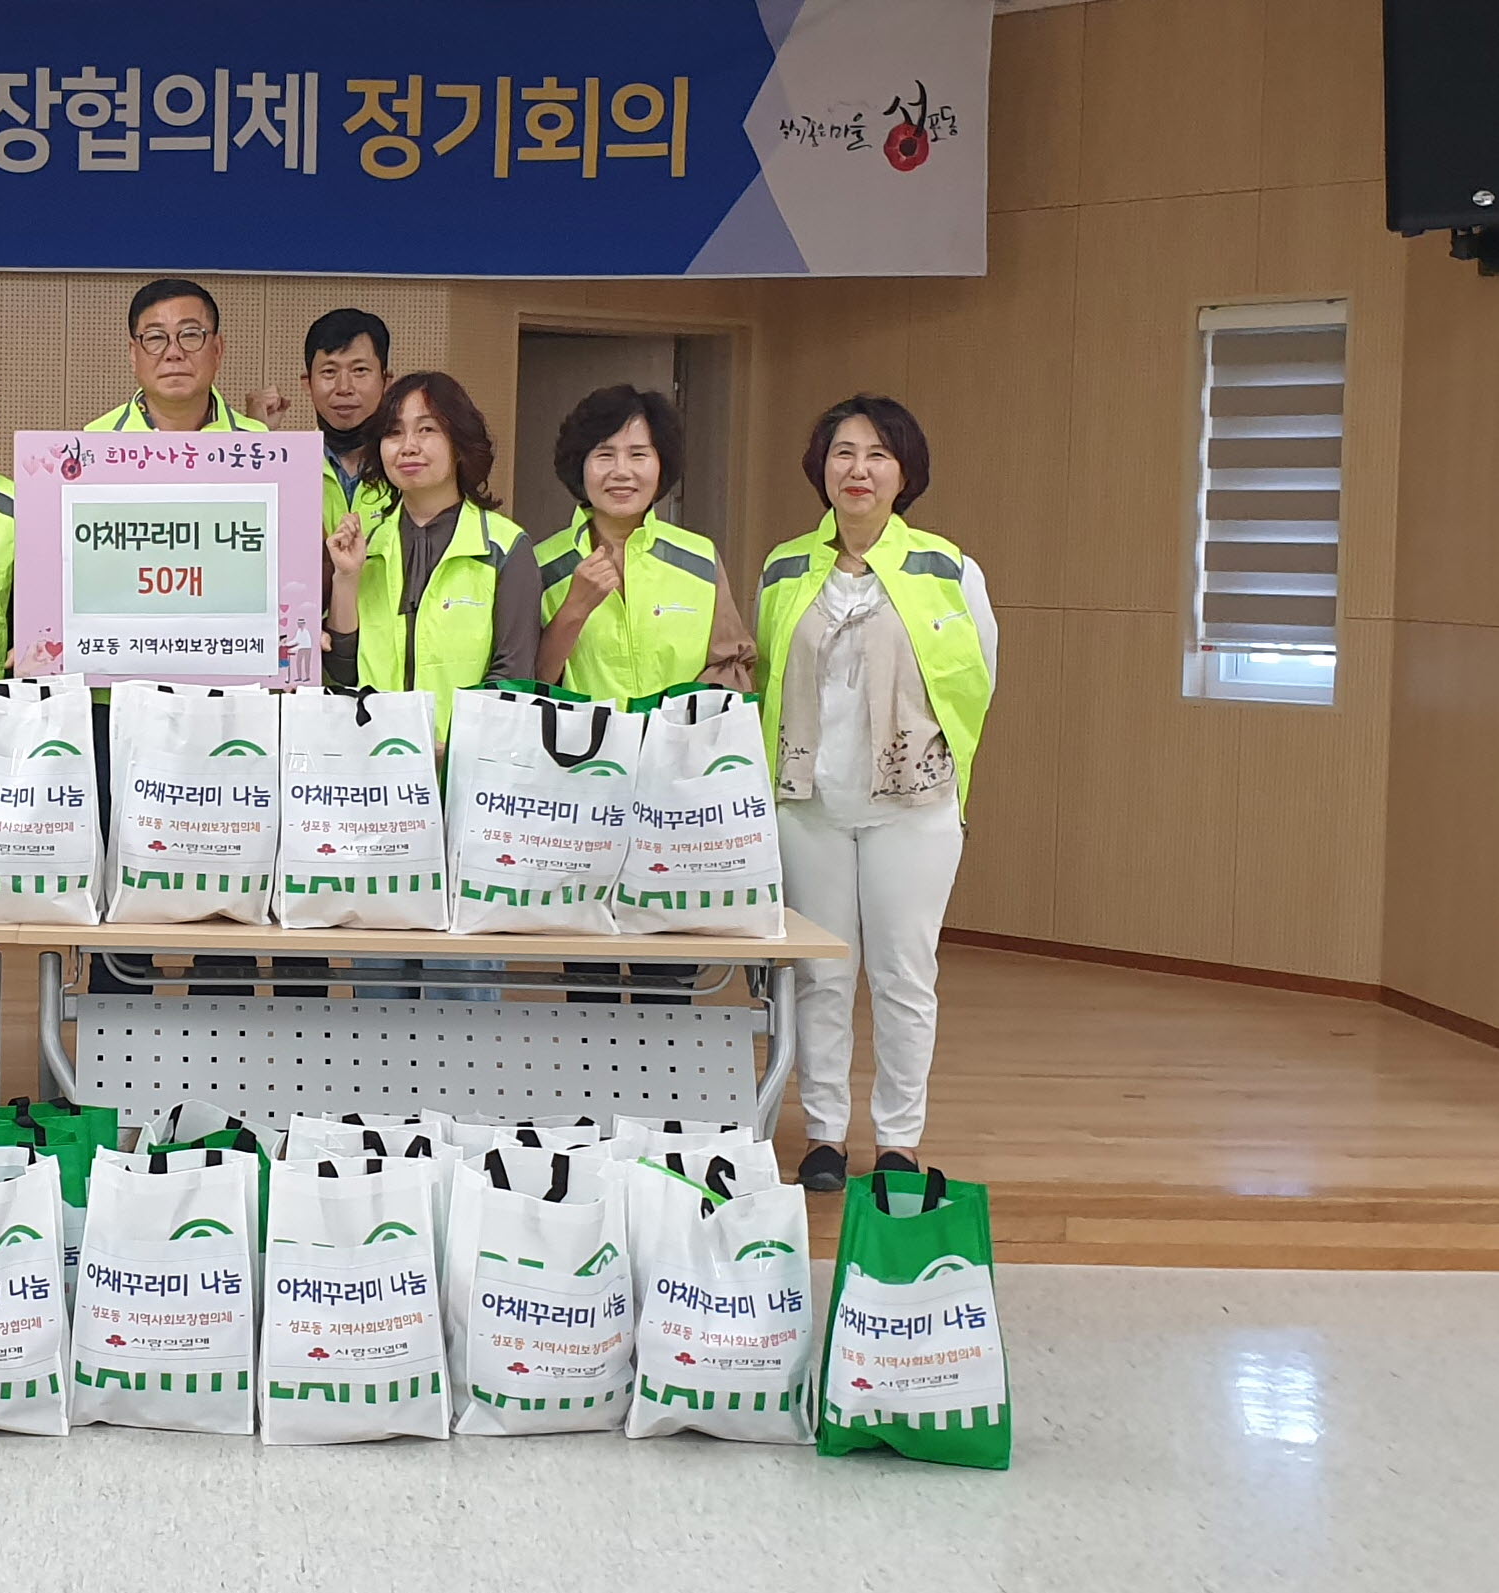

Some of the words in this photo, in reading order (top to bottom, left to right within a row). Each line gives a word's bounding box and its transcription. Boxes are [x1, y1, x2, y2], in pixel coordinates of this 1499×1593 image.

[343, 73, 691, 179] 정기회의
[105, 445, 199, 469] 희망나눔
[208, 443, 288, 470] 이웃돕기
[75, 522, 199, 551] 야채꾸러미
[215, 522, 264, 551] 나눔
[137, 566, 202, 597] 50개
[77, 638, 120, 655] 성포동
[129, 638, 264, 654] 지역사회보장협의체
[47, 786, 85, 807] 나눔
[134, 779, 222, 807] 야채꾸러미
[232, 786, 271, 808] 나눔
[291, 785, 388, 807] 야채꾸러미
[398, 784, 431, 805] 나눔
[475, 792, 579, 824] 야채꾸러미
[591, 805, 626, 826] 나눔
[633, 801, 723, 830] 야채꾸러미
[733, 796, 767, 817] 나눔
[137, 815, 162, 829] 성포동
[169, 820, 261, 832] 지역사회보장협의체
[301, 820, 331, 832] 성포동
[338, 820, 426, 833] 지역사회보장협의체
[482, 828, 513, 843] 성포동
[520, 834, 612, 851] 지역사회보장협의체
[670, 832, 762, 854] 지역사회보장협의체
[64, 1242, 81, 1266] 눔
[9, 1275, 50, 1300] 나눔
[87, 1263, 189, 1296] 야채꾸러미
[201, 1268, 242, 1295] 나눔
[277, 1278, 383, 1305] 야채꾸러미
[390, 1271, 428, 1296] 나눔
[482, 1292, 596, 1328] 야채꾸러미
[603, 1292, 626, 1319] 나눔
[657, 1279, 755, 1318] 야채꾸러미
[768, 1288, 803, 1314] 나눔
[91, 1304, 120, 1322] 성포동
[128, 1311, 233, 1326] 지역사회보장협의체
[289, 1321, 322, 1335] 성포동
[330, 1312, 423, 1335] 지역사회보장협의체
[838, 1304, 932, 1340] 야채꾸러미
[943, 1304, 987, 1329] 나눔
[491, 1334, 525, 1350] 성포동
[661, 1321, 693, 1340] 성포동
[700, 1329, 797, 1349] 지역사회보장협의체
[874, 1346, 981, 1368] 지역사회보장협의체
